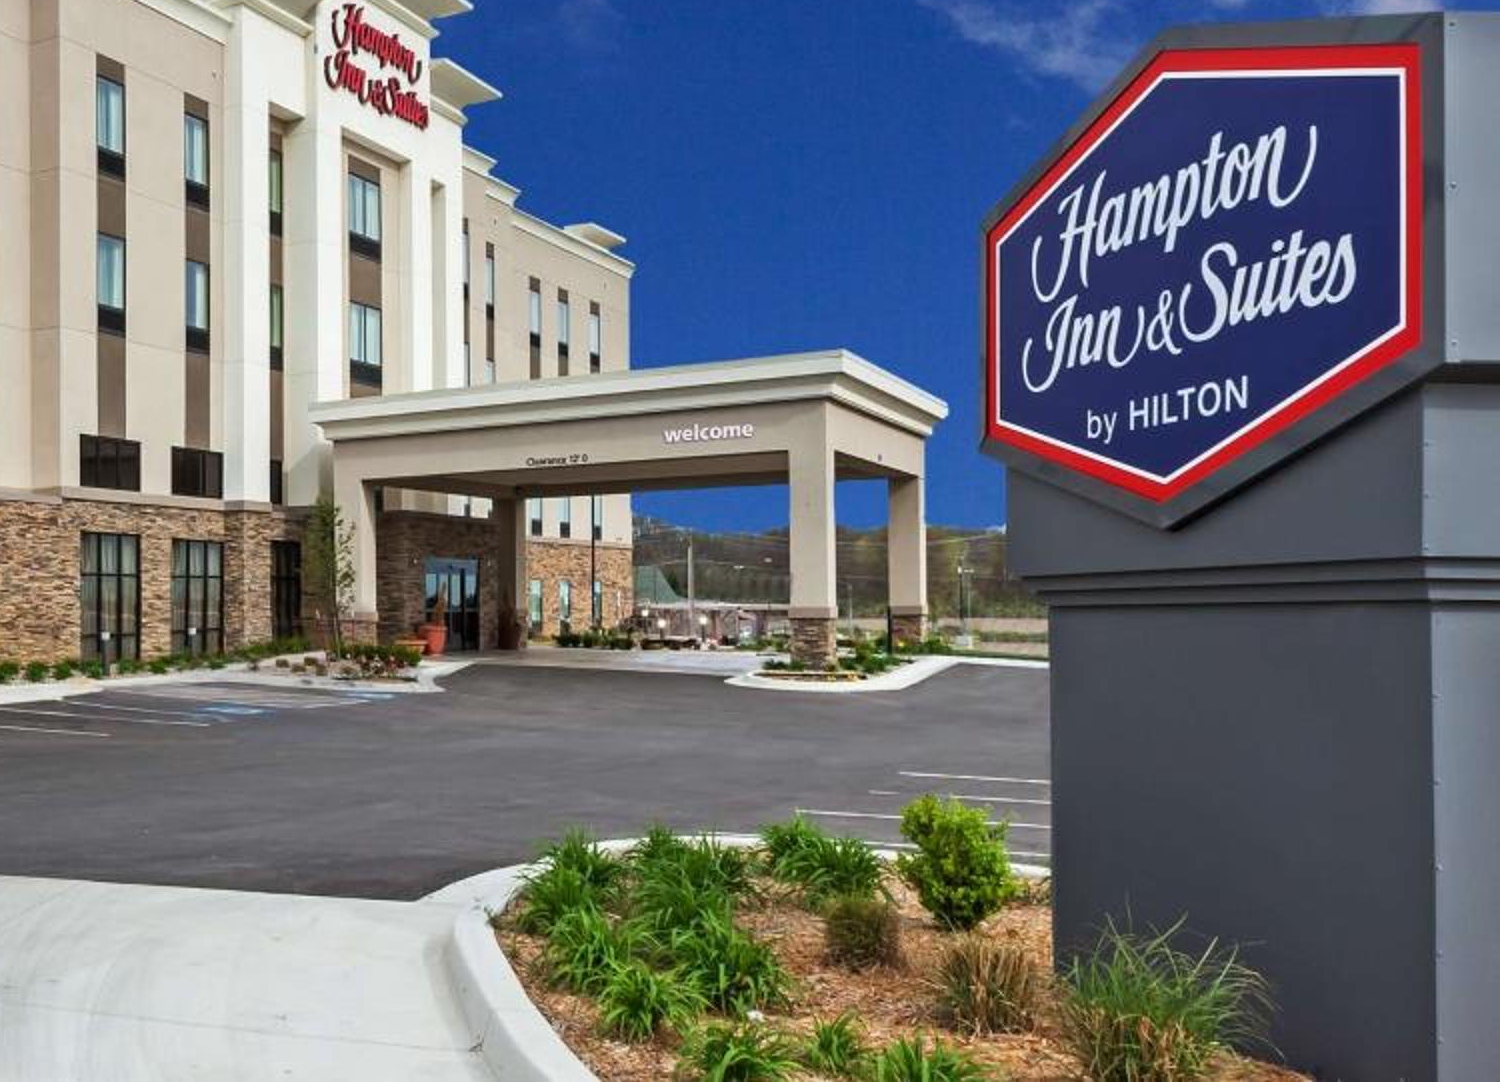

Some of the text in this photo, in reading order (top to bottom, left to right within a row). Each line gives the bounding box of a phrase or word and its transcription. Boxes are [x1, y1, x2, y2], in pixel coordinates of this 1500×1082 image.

[324, 50, 373, 104] Inn
[332, 4, 422, 83] Hampton
[1031, 125, 1317, 302] Hampton
[1022, 229, 1357, 393] Inn & Suites
[664, 423, 754, 443] welcome
[1087, 375, 1249, 444] by HILTON
